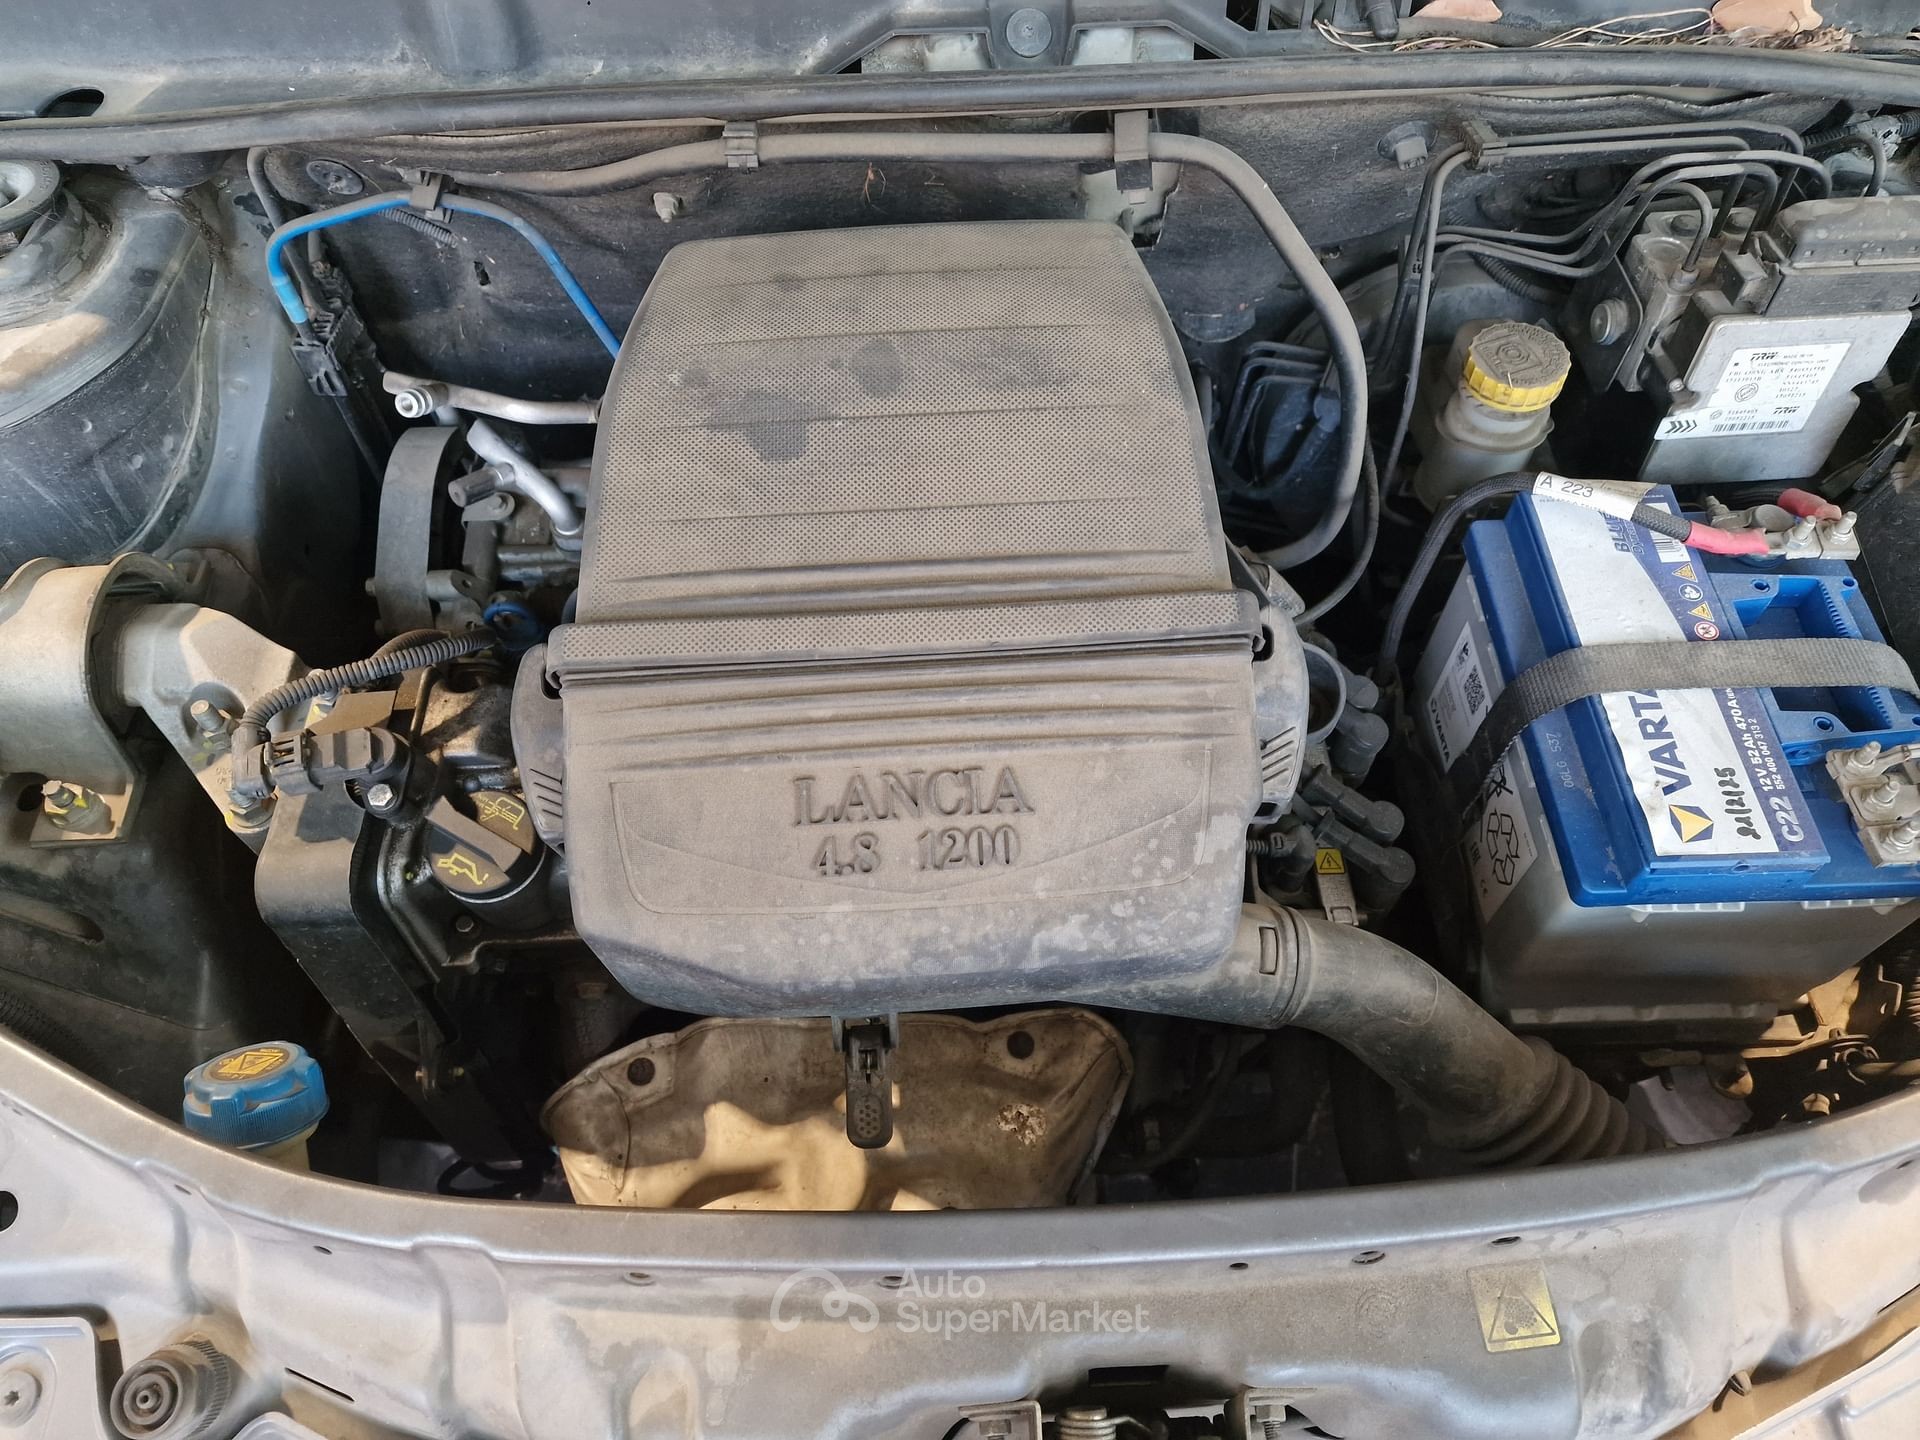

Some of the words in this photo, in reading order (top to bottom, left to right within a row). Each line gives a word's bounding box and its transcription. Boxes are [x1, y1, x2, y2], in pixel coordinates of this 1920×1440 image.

[1539, 474, 1553, 488] A
[1561, 480, 1594, 498] 223
[1748, 717, 1758, 725] 2
[1751, 724, 1764, 739] 313
[1432, 709, 1450, 763] VARTA
[1546, 732, 1562, 752] 537
[1743, 732, 1762, 764] 52Ah
[1757, 740, 1771, 756] 047
[1765, 756, 1778, 772] 400
[1755, 767, 1774, 792] 12V
[1774, 774, 1786, 790] 552
[792, 765, 1035, 826] LANCIA
[1769, 795, 1805, 842] C22
[916, 823, 1022, 872] 1200
